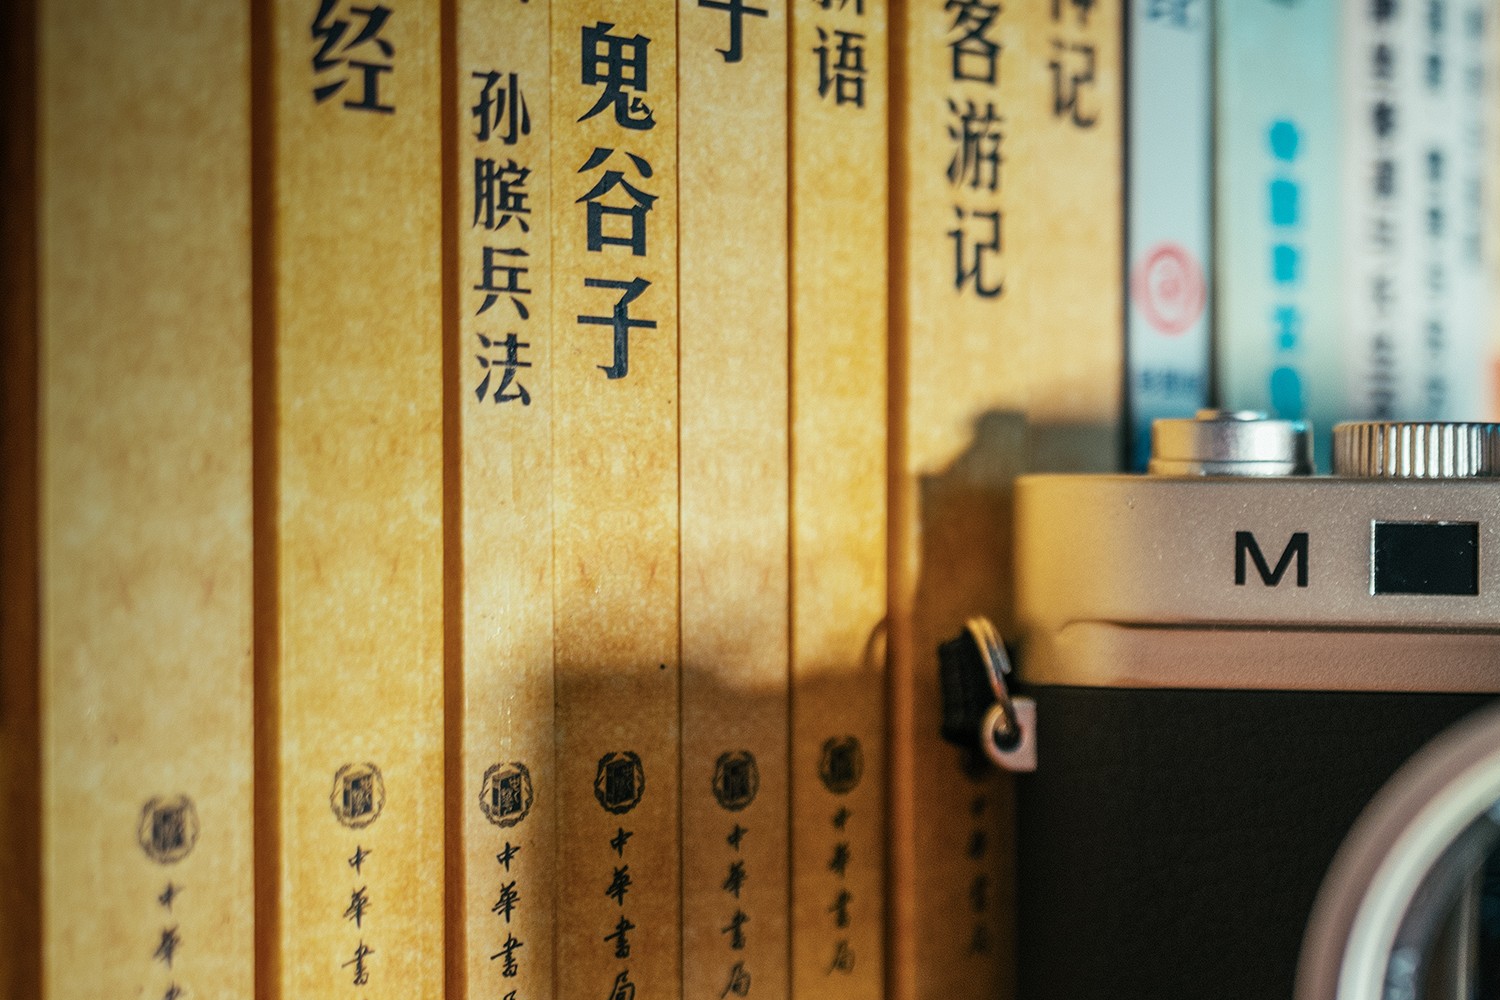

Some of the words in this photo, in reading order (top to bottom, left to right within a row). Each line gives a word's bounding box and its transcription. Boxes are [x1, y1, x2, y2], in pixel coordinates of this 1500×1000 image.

[309, 0, 397, 115] 经
[812, 0, 869, 109] 语
[471, 70, 533, 407] 孙膑兵法
[575, 21, 660, 380] 鬼谷子
[1234, 531, 1309, 587] M
[720, 824, 753, 1000] 中華書局
